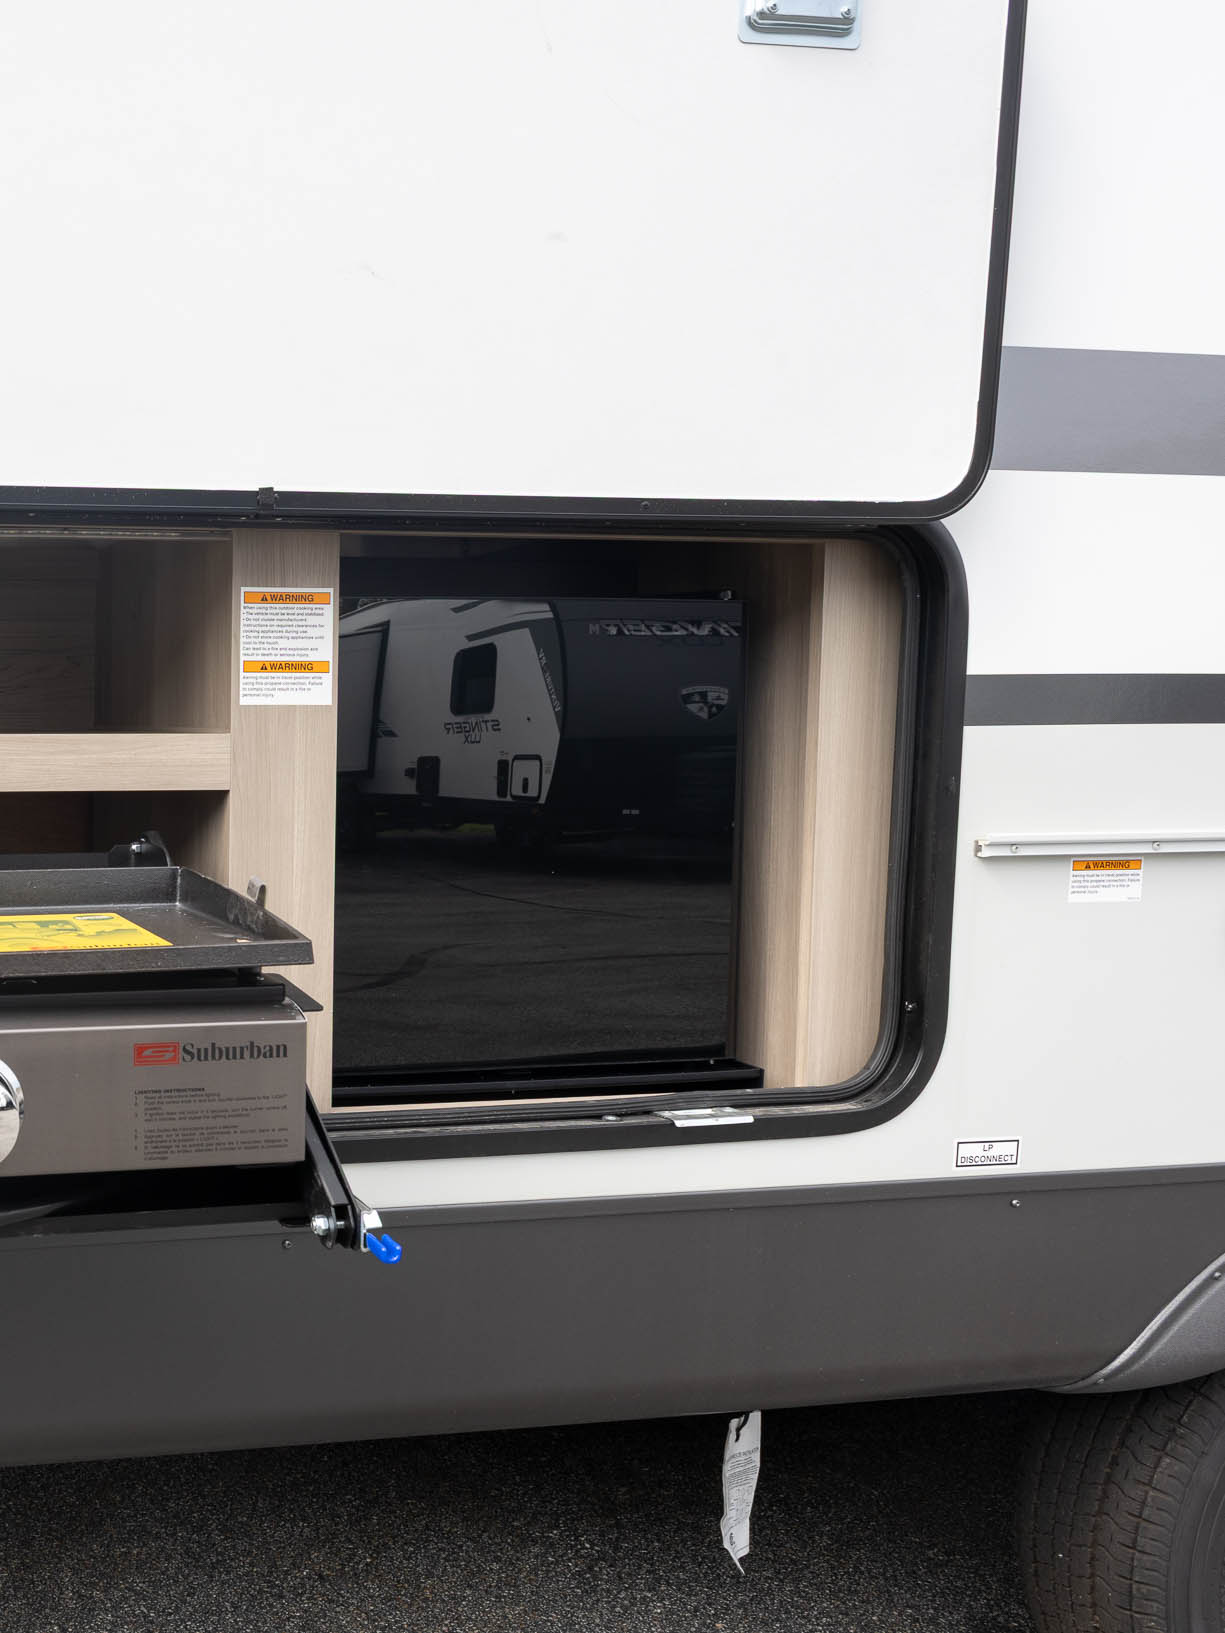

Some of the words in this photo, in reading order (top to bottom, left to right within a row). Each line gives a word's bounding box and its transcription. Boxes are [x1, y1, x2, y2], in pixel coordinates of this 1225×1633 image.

[270, 594, 314, 602] WARNING
[270, 663, 313, 671] WARNING
[182, 1041, 288, 1062] Suburban
[983, 1144, 994, 1152] LP
[960, 1154, 1015, 1164] DISCONNECT
